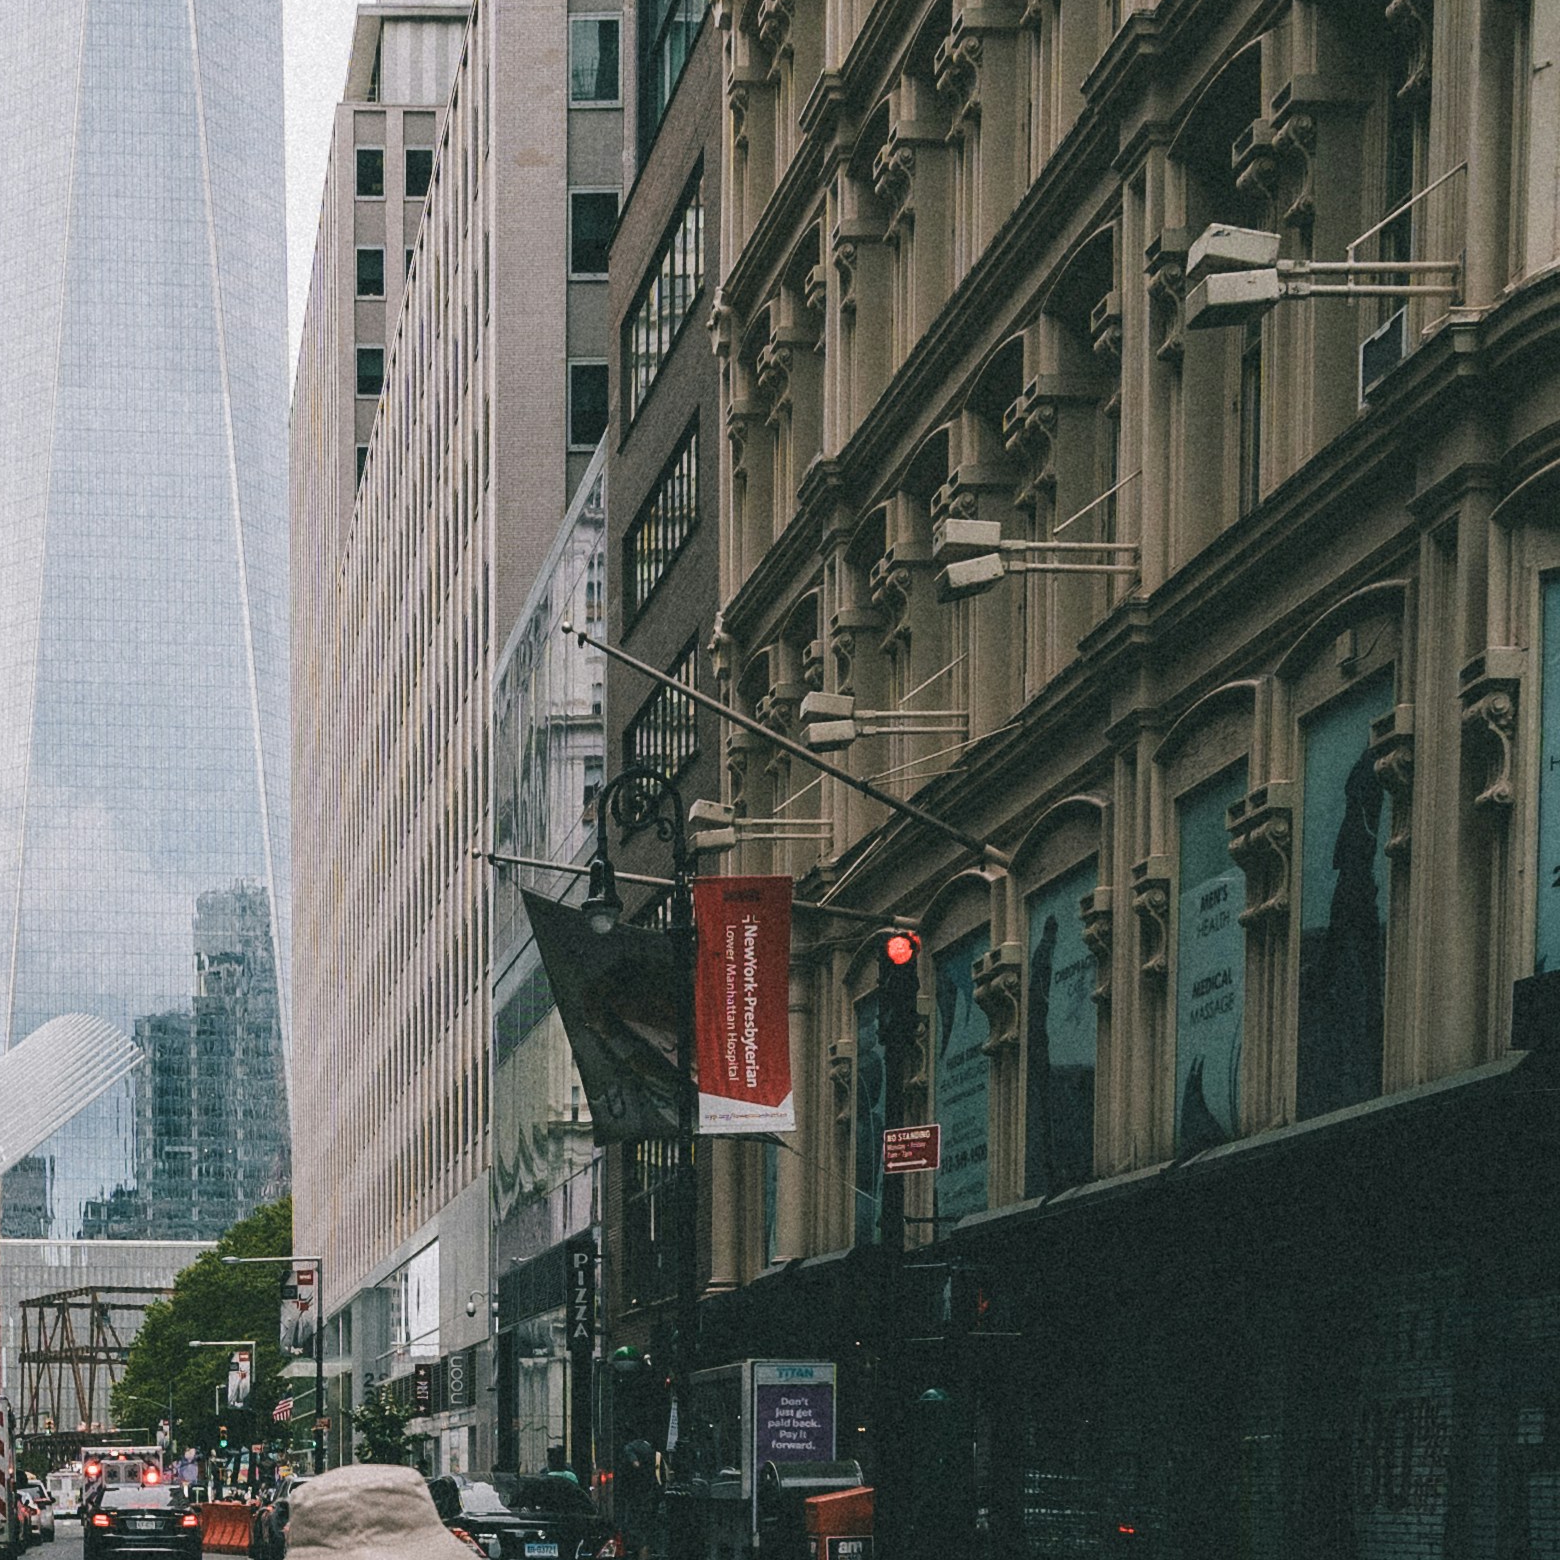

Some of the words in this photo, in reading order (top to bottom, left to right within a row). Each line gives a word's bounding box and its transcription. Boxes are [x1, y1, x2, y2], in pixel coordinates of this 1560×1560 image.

[725, 925, 737, 961] Lower
[726, 963, 737, 1030] Manhattan
[743, 925, 758, 1089] NewYork-Presbyterian
[727, 1032, 739, 1081] Hospital
[887, 1134, 897, 1142] NO
[897, 1129, 931, 1142] STANDING
[573, 1253, 589, 1338] PIZZA
[776, 1367, 814, 1379] TITAN
[780, 1397, 809, 1406] Don't
[796, 1408, 812, 1418] get
[768, 1419, 791, 1429] paid
[792, 1418, 821, 1428] back.
[779, 1430, 797, 1439] Pay
[771, 1439, 816, 1450] forward.
